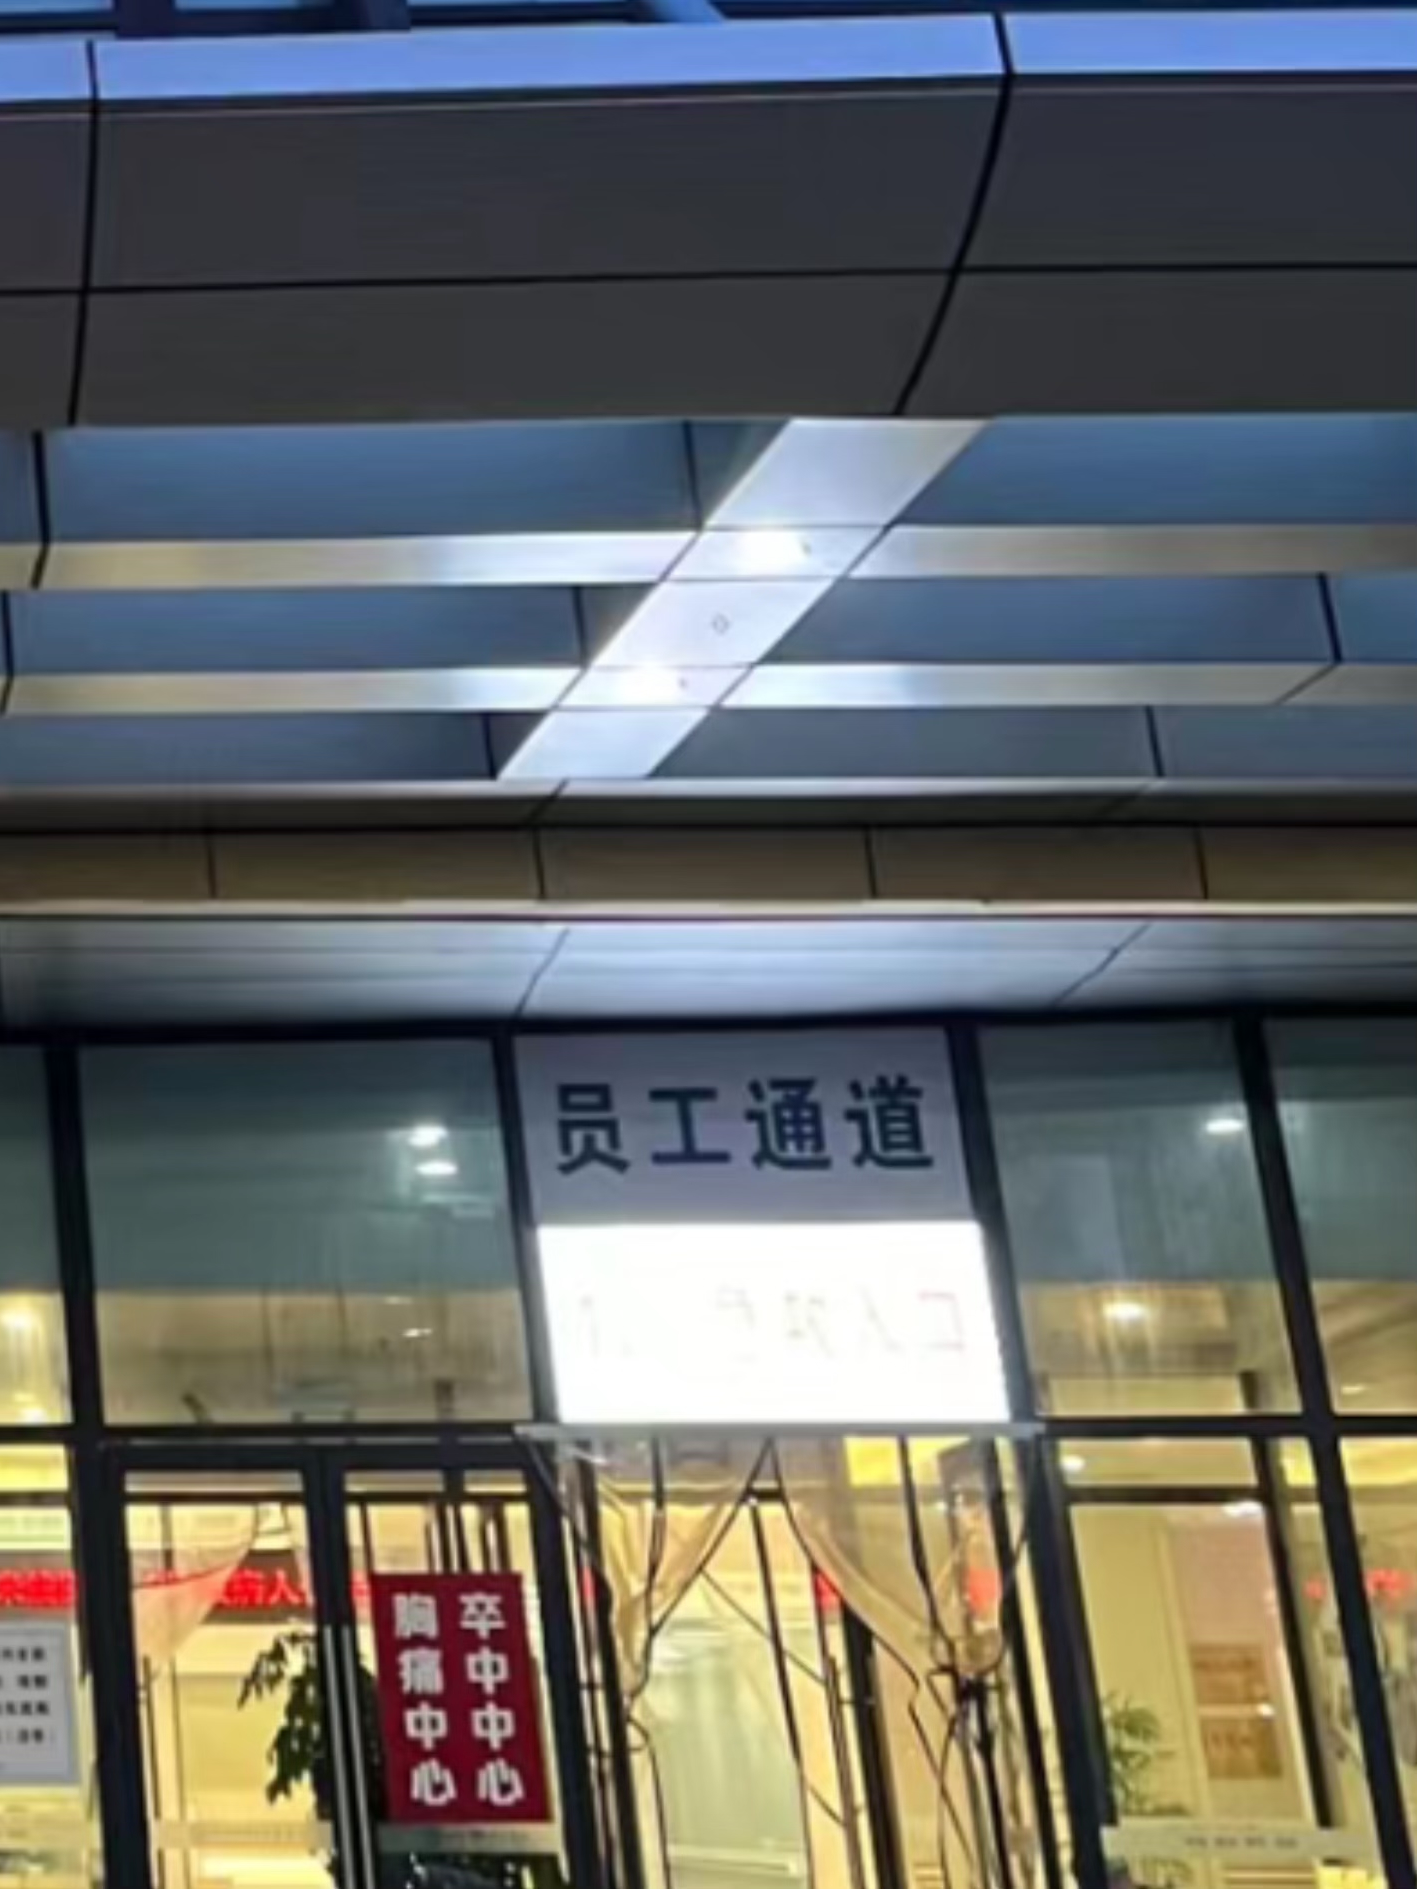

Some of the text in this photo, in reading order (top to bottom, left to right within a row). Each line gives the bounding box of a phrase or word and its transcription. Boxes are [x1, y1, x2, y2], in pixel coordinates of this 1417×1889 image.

[555, 1074, 937, 1176] 员工通道
[392, 1592, 457, 1807] 胸痛中心
[457, 1590, 525, 1807] 卒中中心
